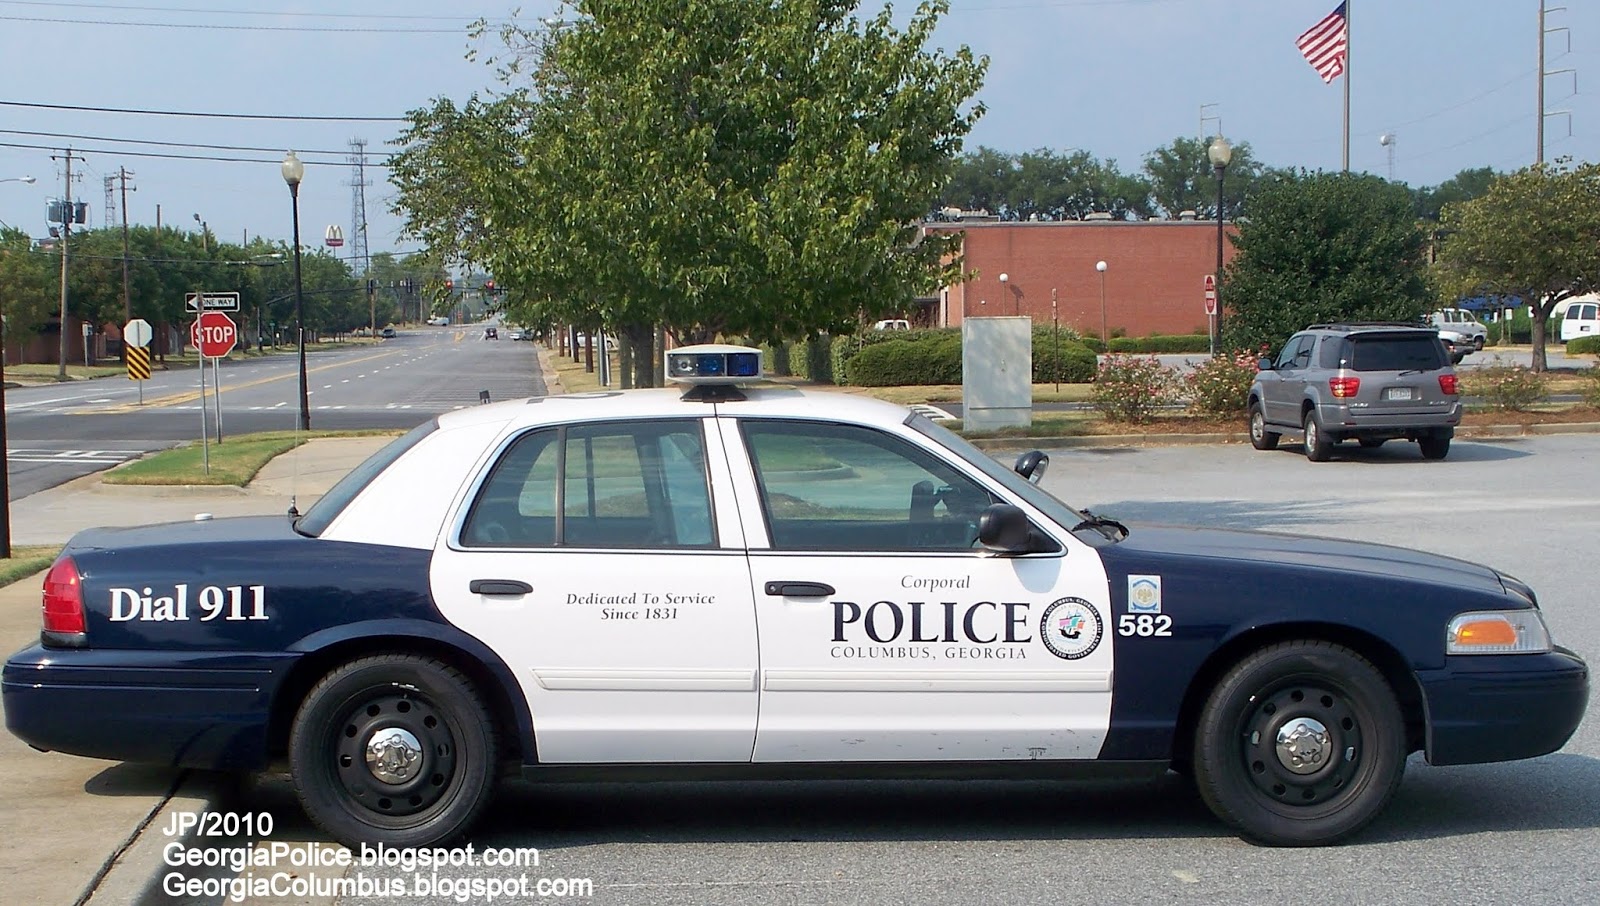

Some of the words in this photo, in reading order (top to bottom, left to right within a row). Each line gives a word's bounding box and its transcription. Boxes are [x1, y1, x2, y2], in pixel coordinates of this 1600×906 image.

[195, 326, 233, 343] STOP
[901, 575, 970, 592] Corporal
[109, 584, 190, 621] Dial
[199, 585, 269, 621] 911
[566, 593, 636, 604] Dedicated
[643, 593, 659, 604] To
[664, 593, 715, 604] Service
[601, 608, 639, 620] Since
[645, 608, 677, 619] 1831
[830, 601, 1032, 643] POLICE
[1118, 615, 1172, 636] 582
[831, 647, 935, 660] COLUMBUS,
[945, 647, 1026, 659] GEORGIA
